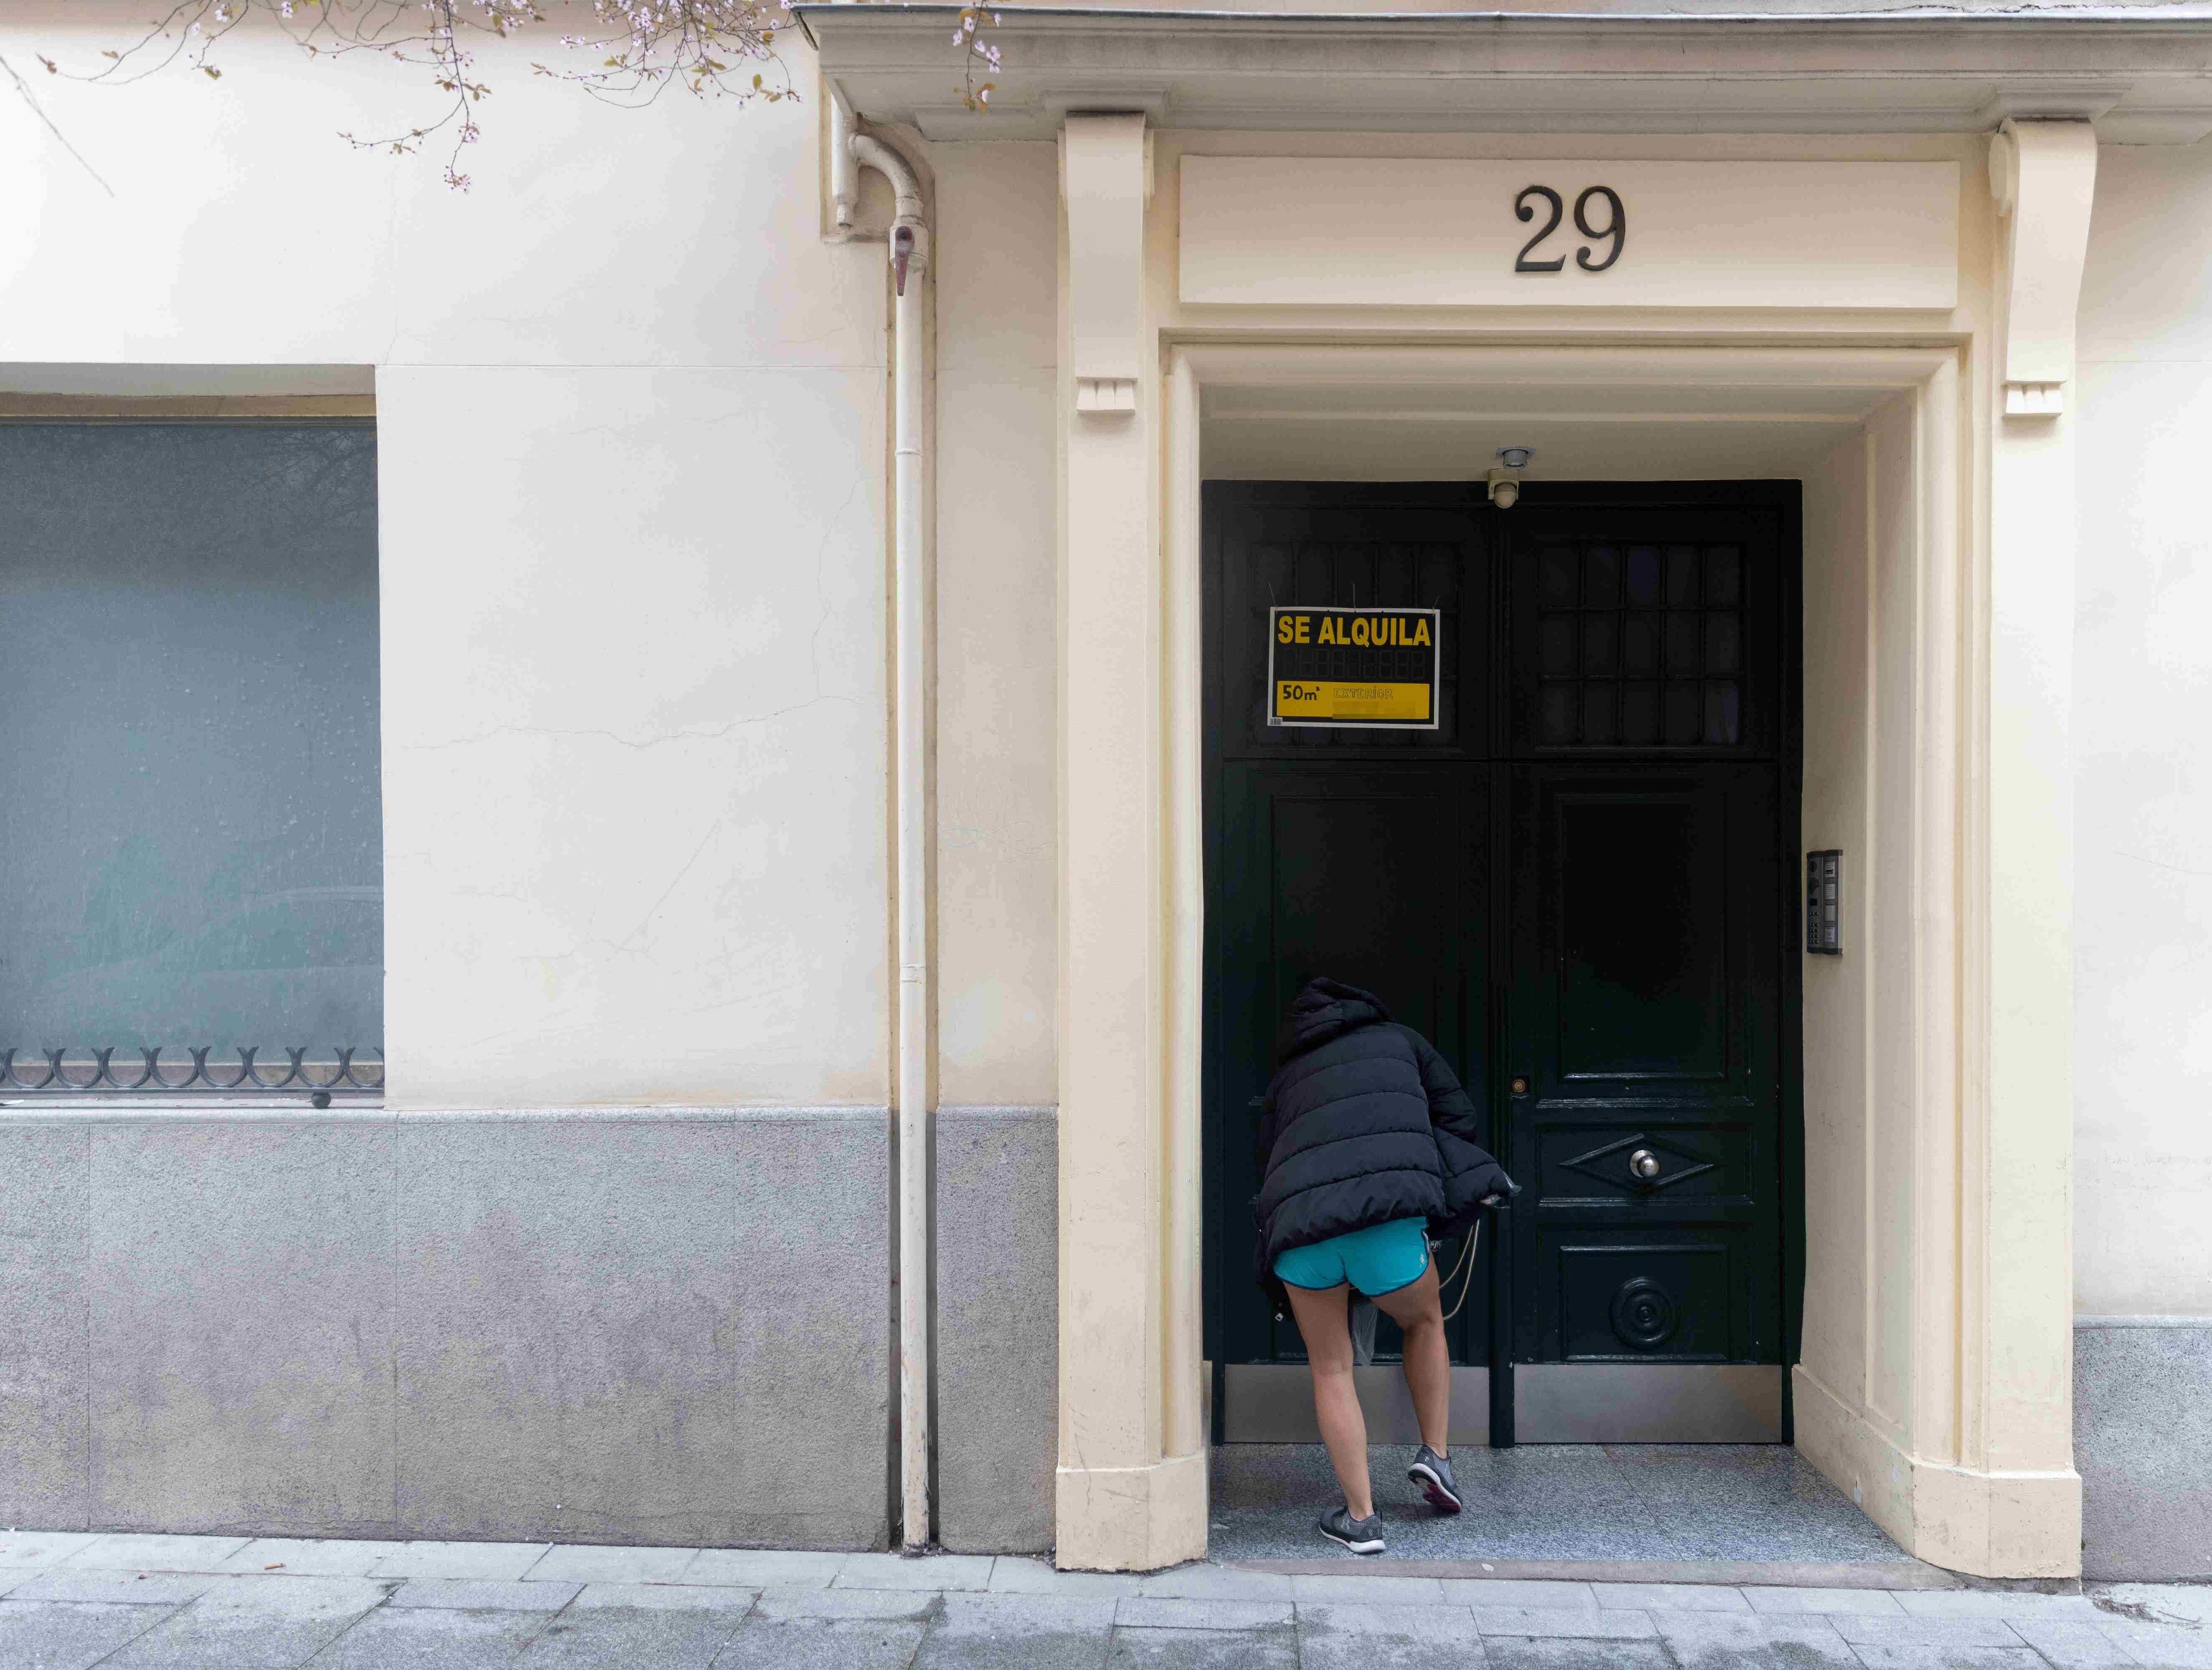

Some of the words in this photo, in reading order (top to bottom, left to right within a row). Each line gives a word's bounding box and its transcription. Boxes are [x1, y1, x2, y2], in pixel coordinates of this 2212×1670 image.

[1515, 185, 1625, 272] 29
[1277, 615, 1310, 644] SE
[1318, 616, 1431, 648] ALQUILA
